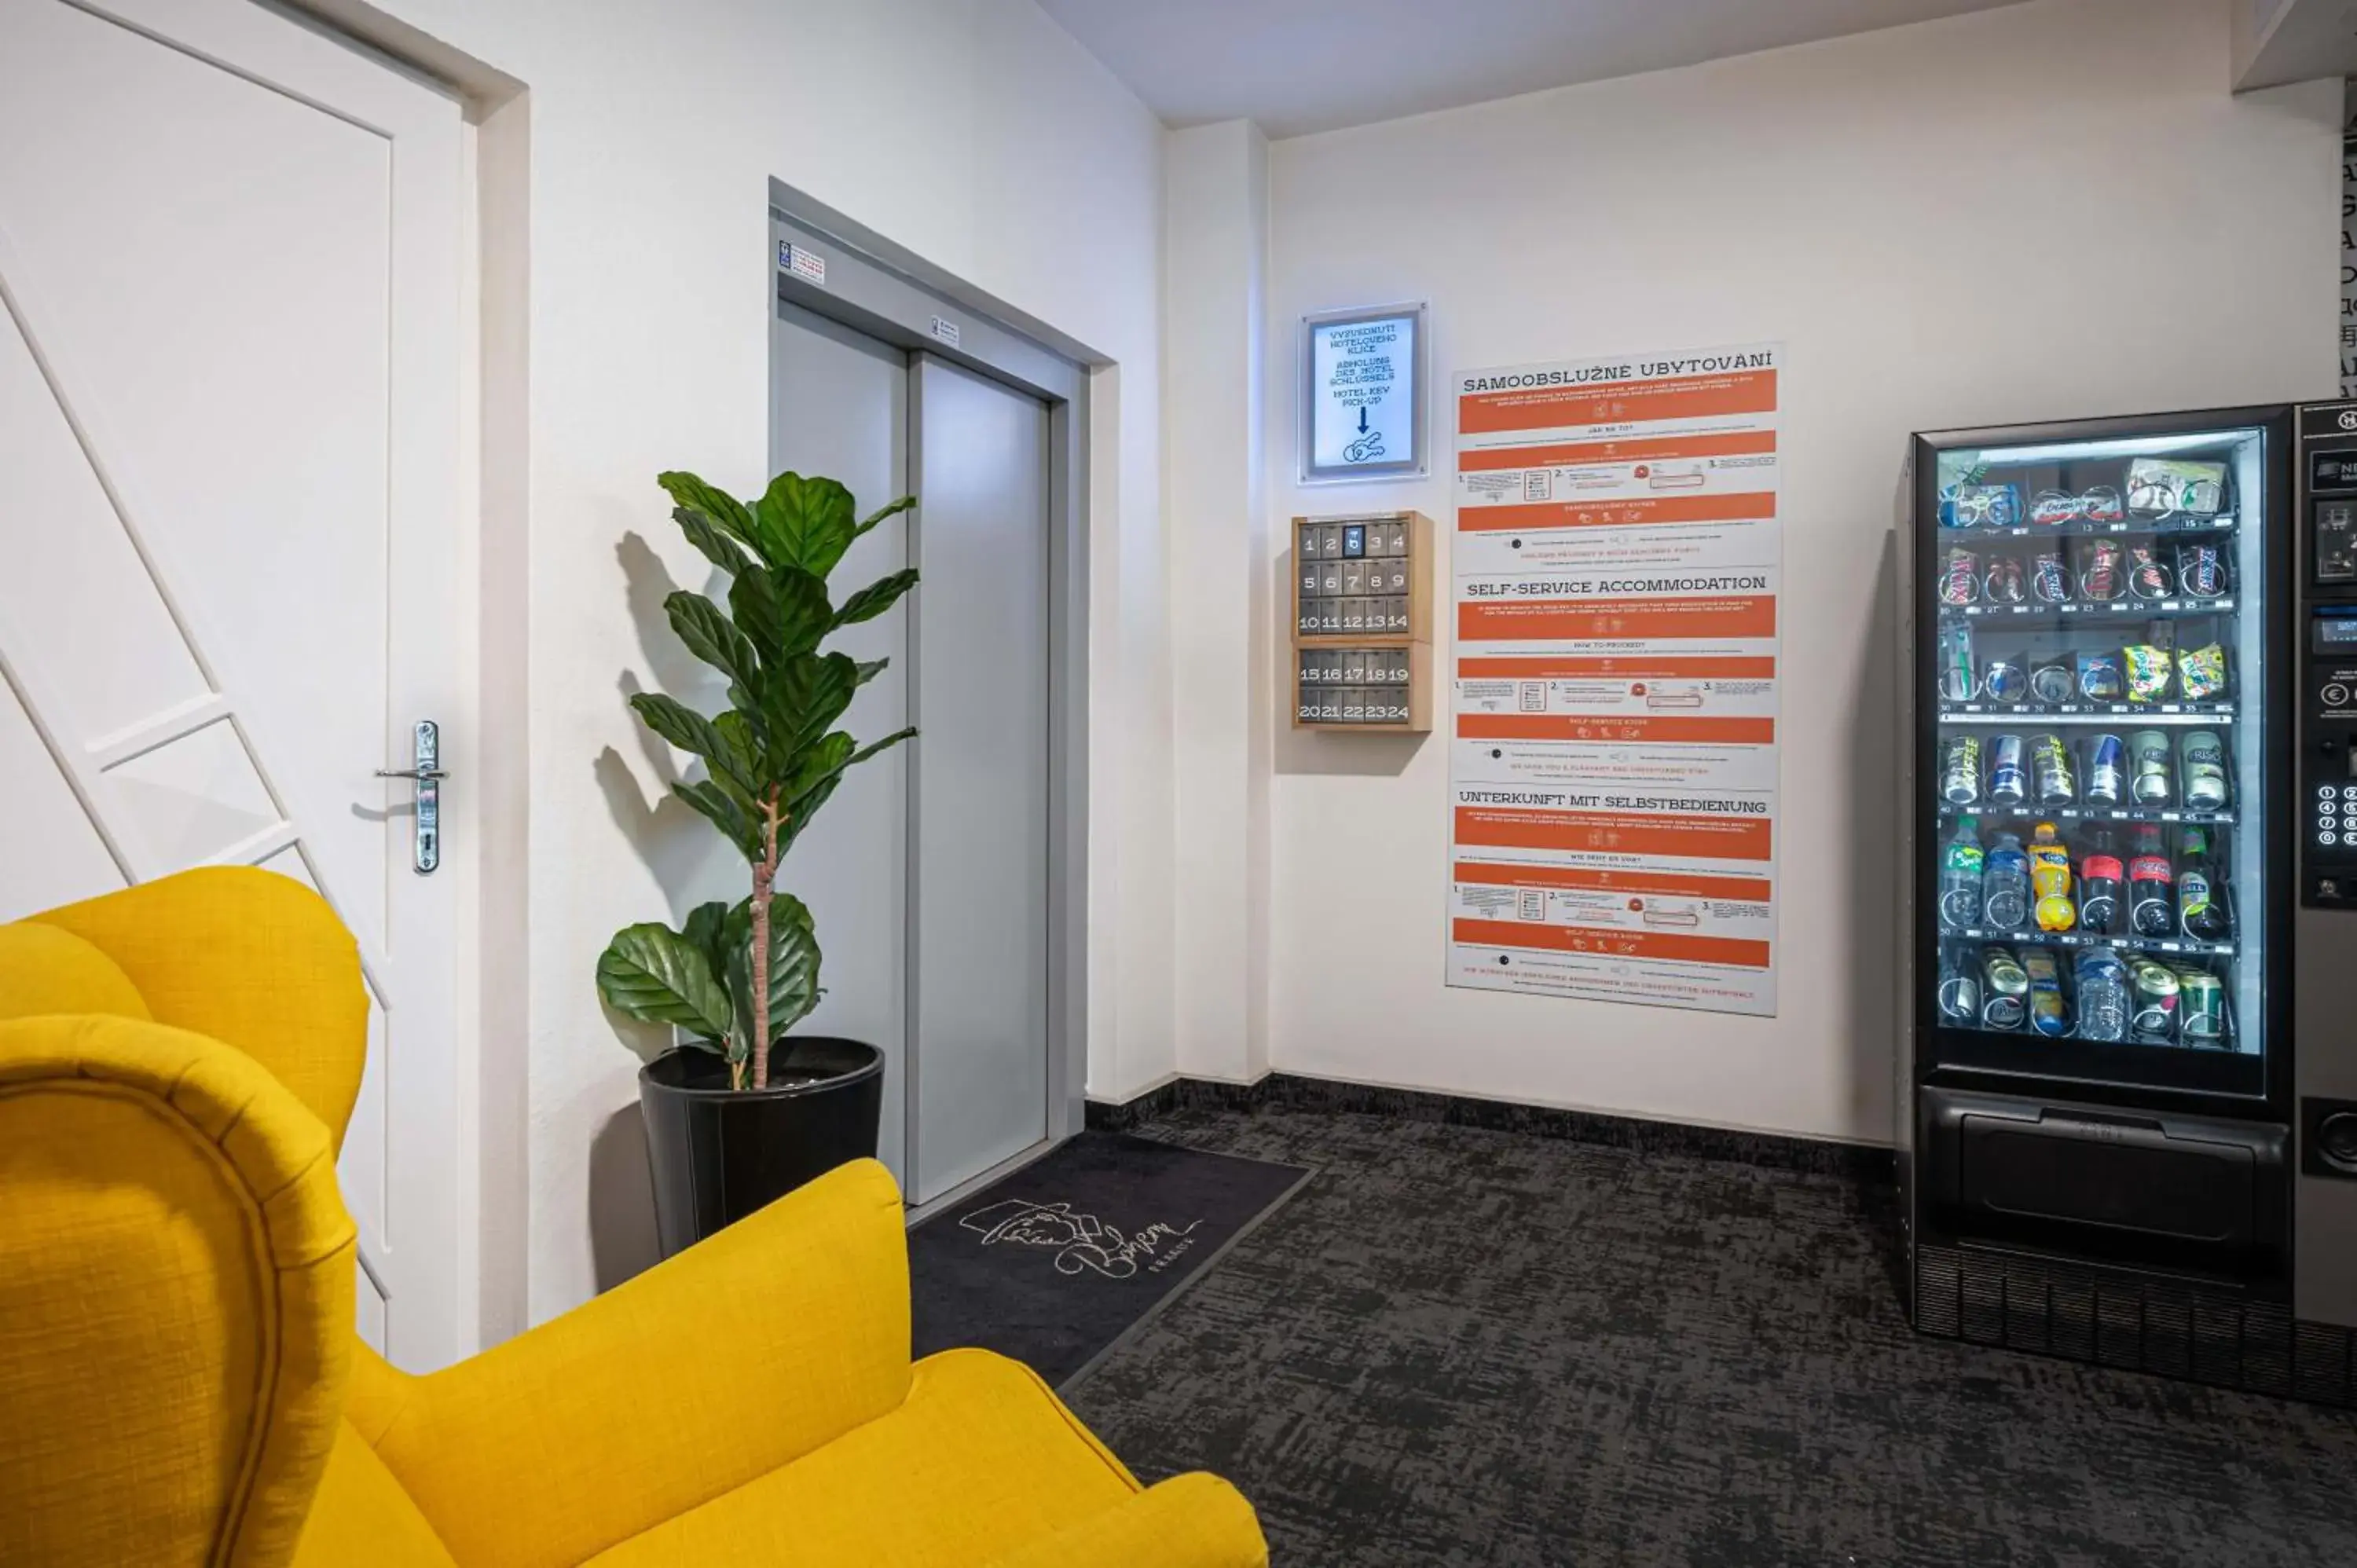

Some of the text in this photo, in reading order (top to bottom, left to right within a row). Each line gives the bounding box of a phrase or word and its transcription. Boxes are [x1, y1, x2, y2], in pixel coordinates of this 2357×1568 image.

[1333, 389, 1366, 398] HOTEL
[1305, 536, 1404, 551] 1 2 3 4
[1304, 575, 1405, 589] 5 6 7 8 9
[1468, 577, 1766, 595] SELF-SERVICE ACCOMMODATION
[1299, 615, 1407, 628] 10 11 12 13 14
[1300, 669, 1409, 681] 15 16 17 18 19
[1299, 706, 1409, 718] 20 21 22 23 24
[1459, 791, 1767, 814] UNTERKUNFT MIT SELBSTBEDIENUNG
